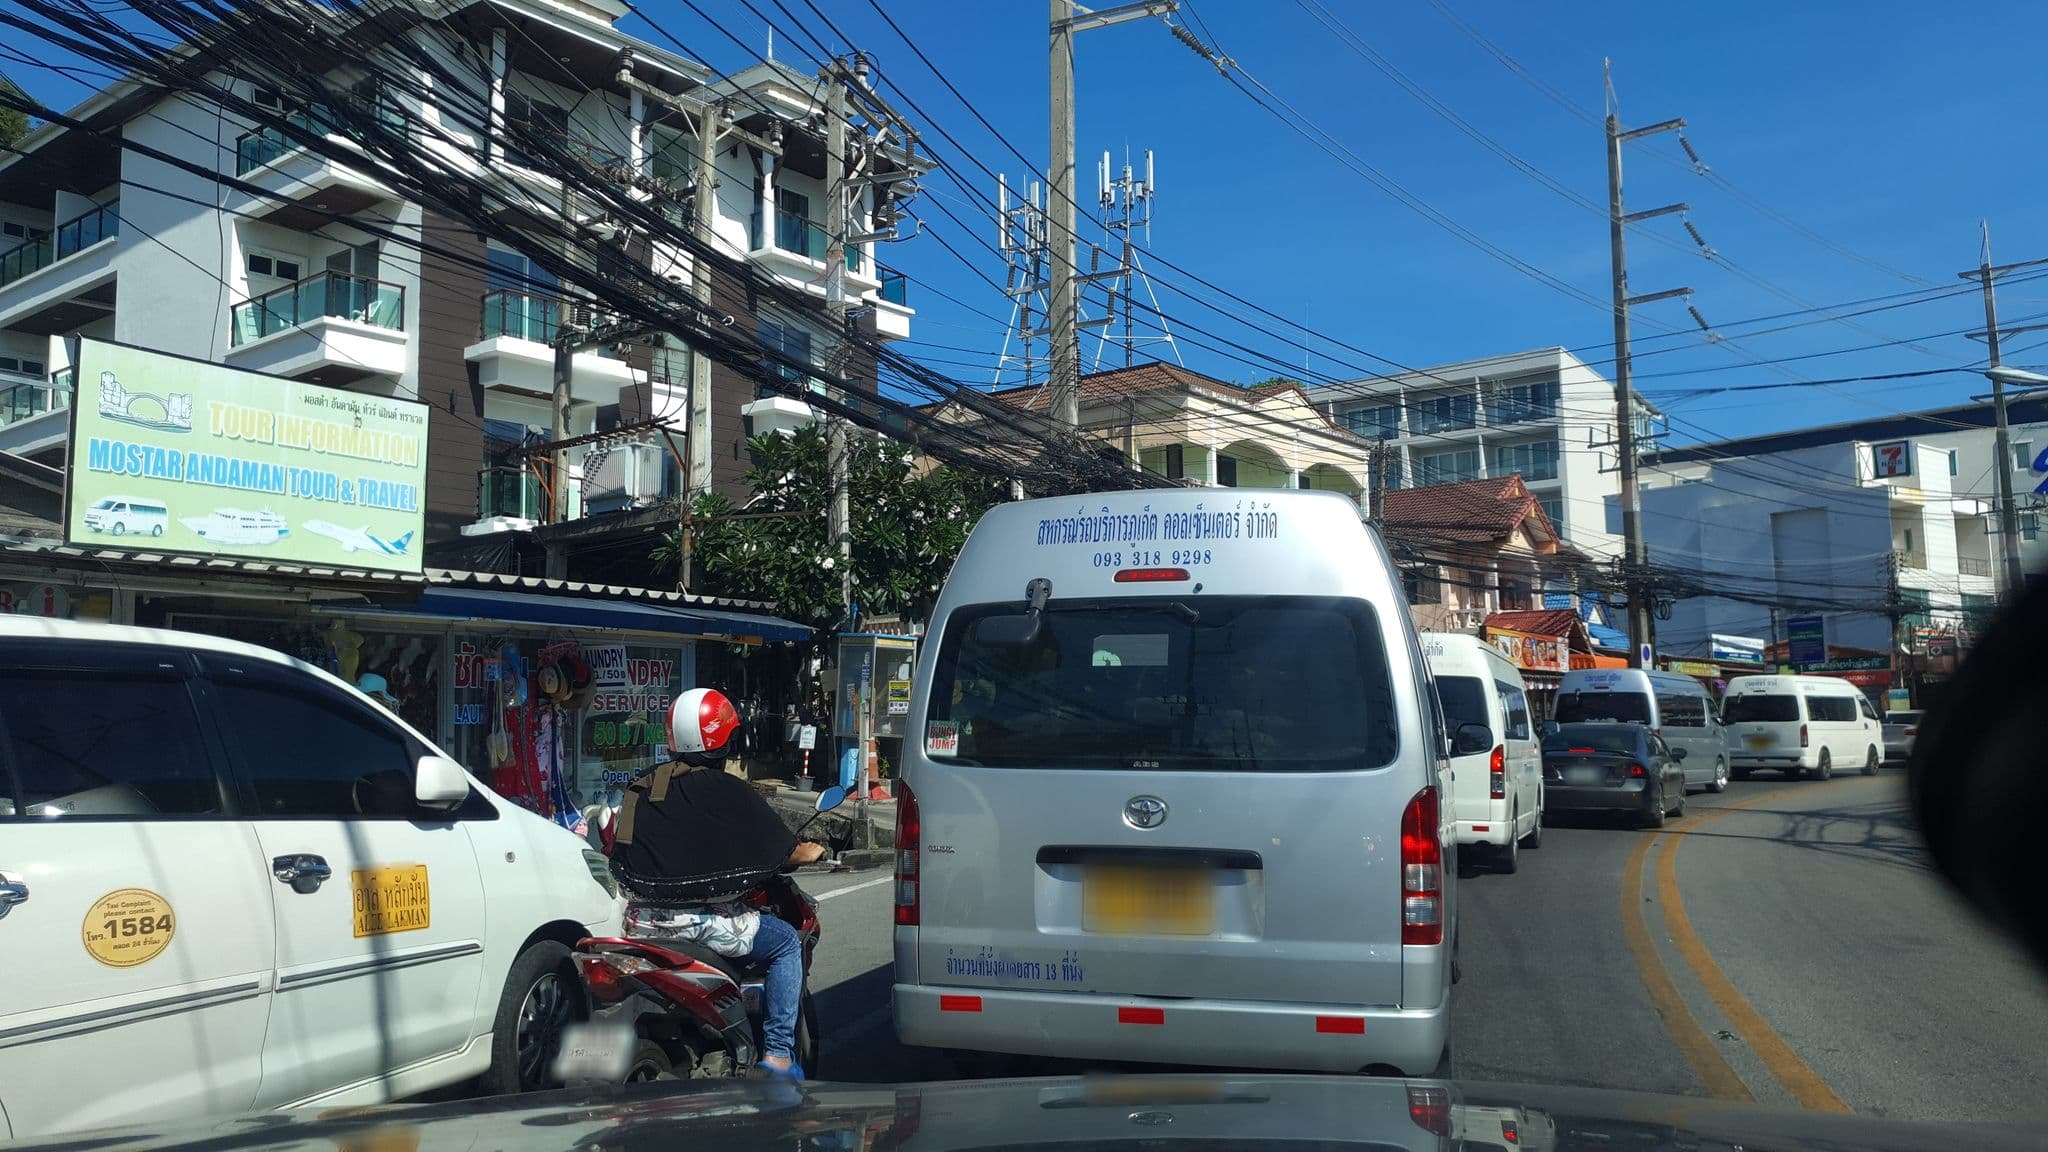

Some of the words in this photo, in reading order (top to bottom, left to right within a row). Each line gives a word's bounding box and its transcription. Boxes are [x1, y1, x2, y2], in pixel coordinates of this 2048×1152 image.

[209, 401, 275, 445] TOUR
[277, 412, 420, 468] INFORMATION
[88, 437, 184, 482] MOSTAR
[185, 451, 287, 495] ANDAMAN
[288, 466, 338, 502] TOUR
[340, 479, 355, 504] &
[357, 476, 418, 513] TRAVEL
[1246, 501, 1278, 540] จำกัด
[1093, 552, 1122, 568] 093
[1132, 551, 1161, 566] 318
[1172, 550, 1212, 565] 9298
[626, 658, 673, 688] NDRY
[593, 692, 670, 713] SERVICE
[929, 739, 956, 750] JUMP
[601, 769, 630, 785] Open
[129, 907, 155, 915] contact
[387, 908, 427, 929] LAKMAN
[103, 914, 172, 938] 1584
[1045, 963, 1057, 981] 13
